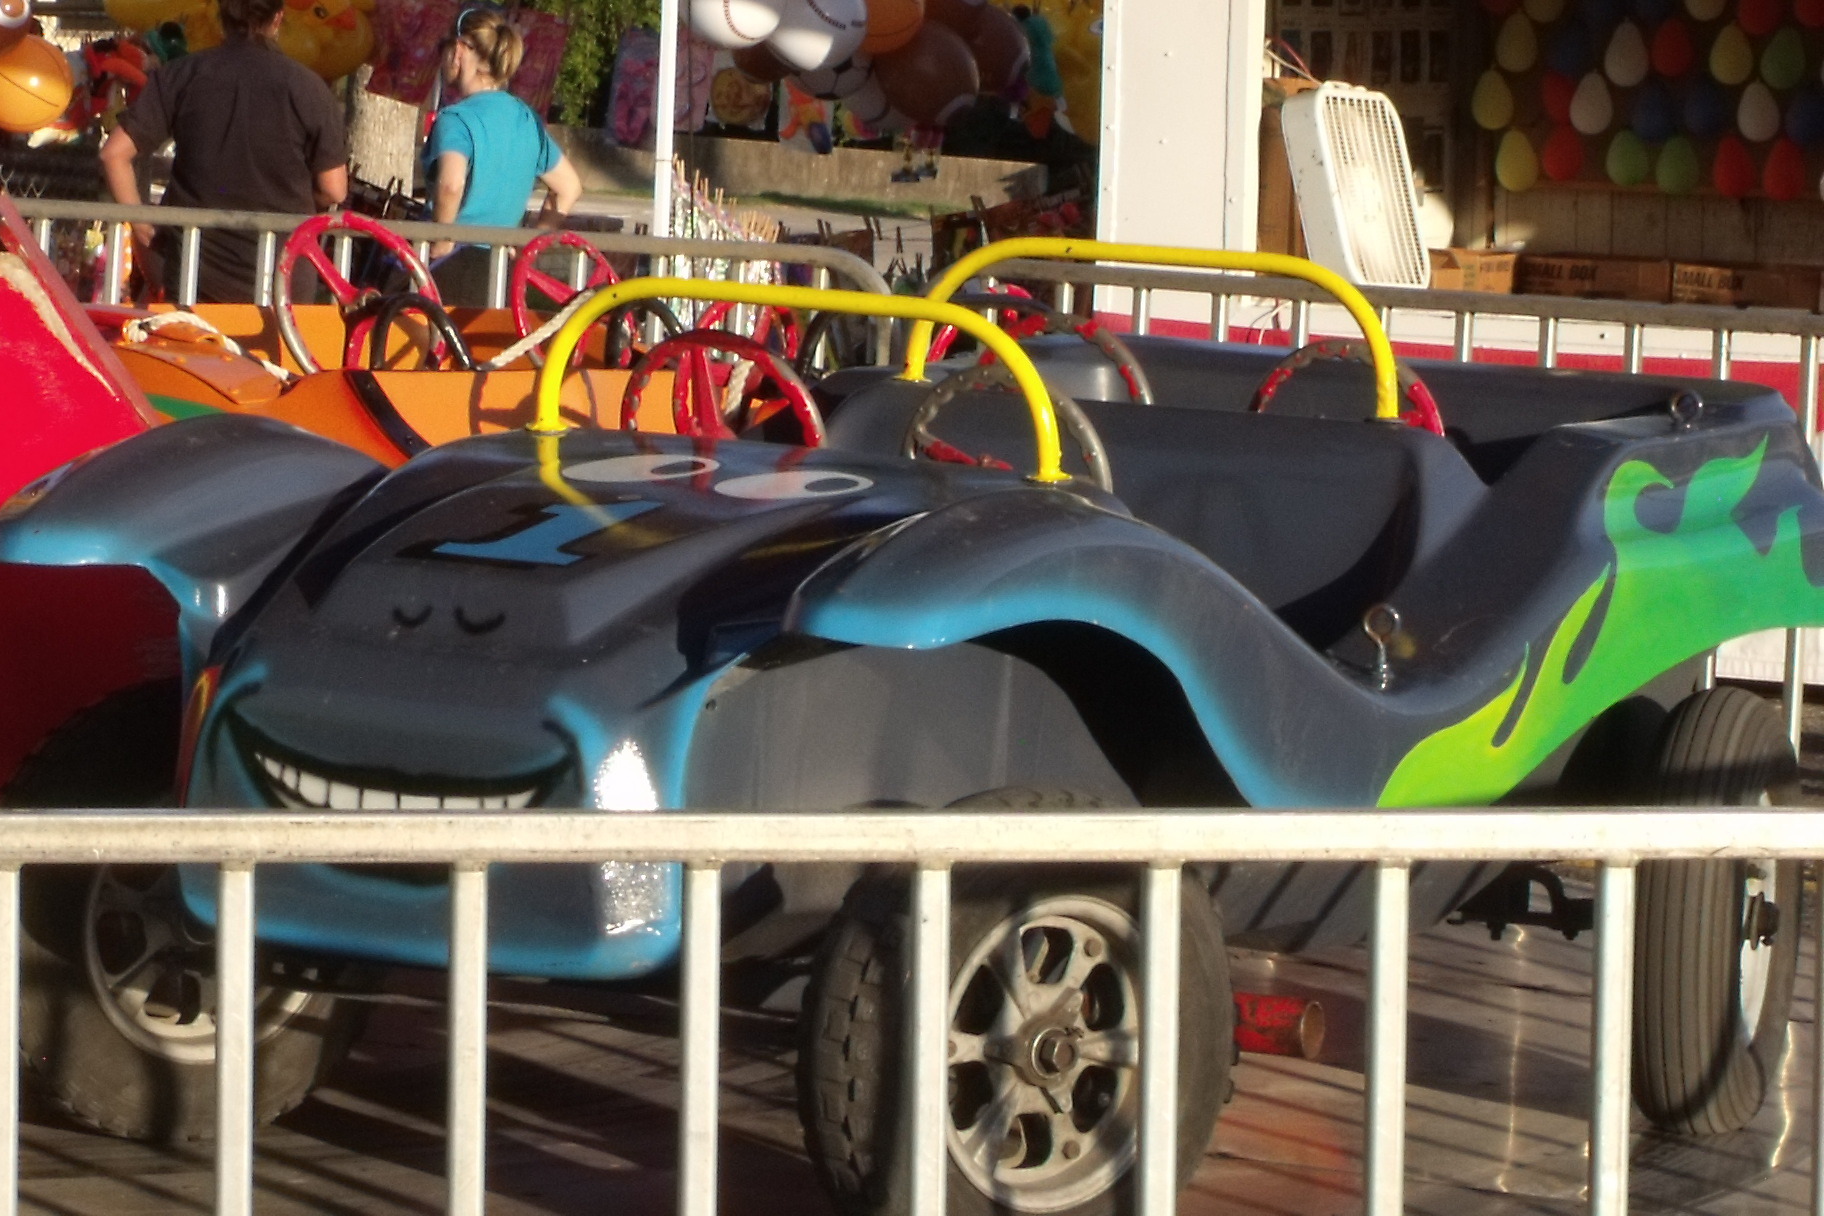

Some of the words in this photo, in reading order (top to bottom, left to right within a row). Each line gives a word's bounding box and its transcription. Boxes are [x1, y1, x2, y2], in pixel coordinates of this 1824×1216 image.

[1568, 264, 1599, 281] BOX
[1677, 270, 1713, 288] SMALL
[431, 499, 666, 567] 1
